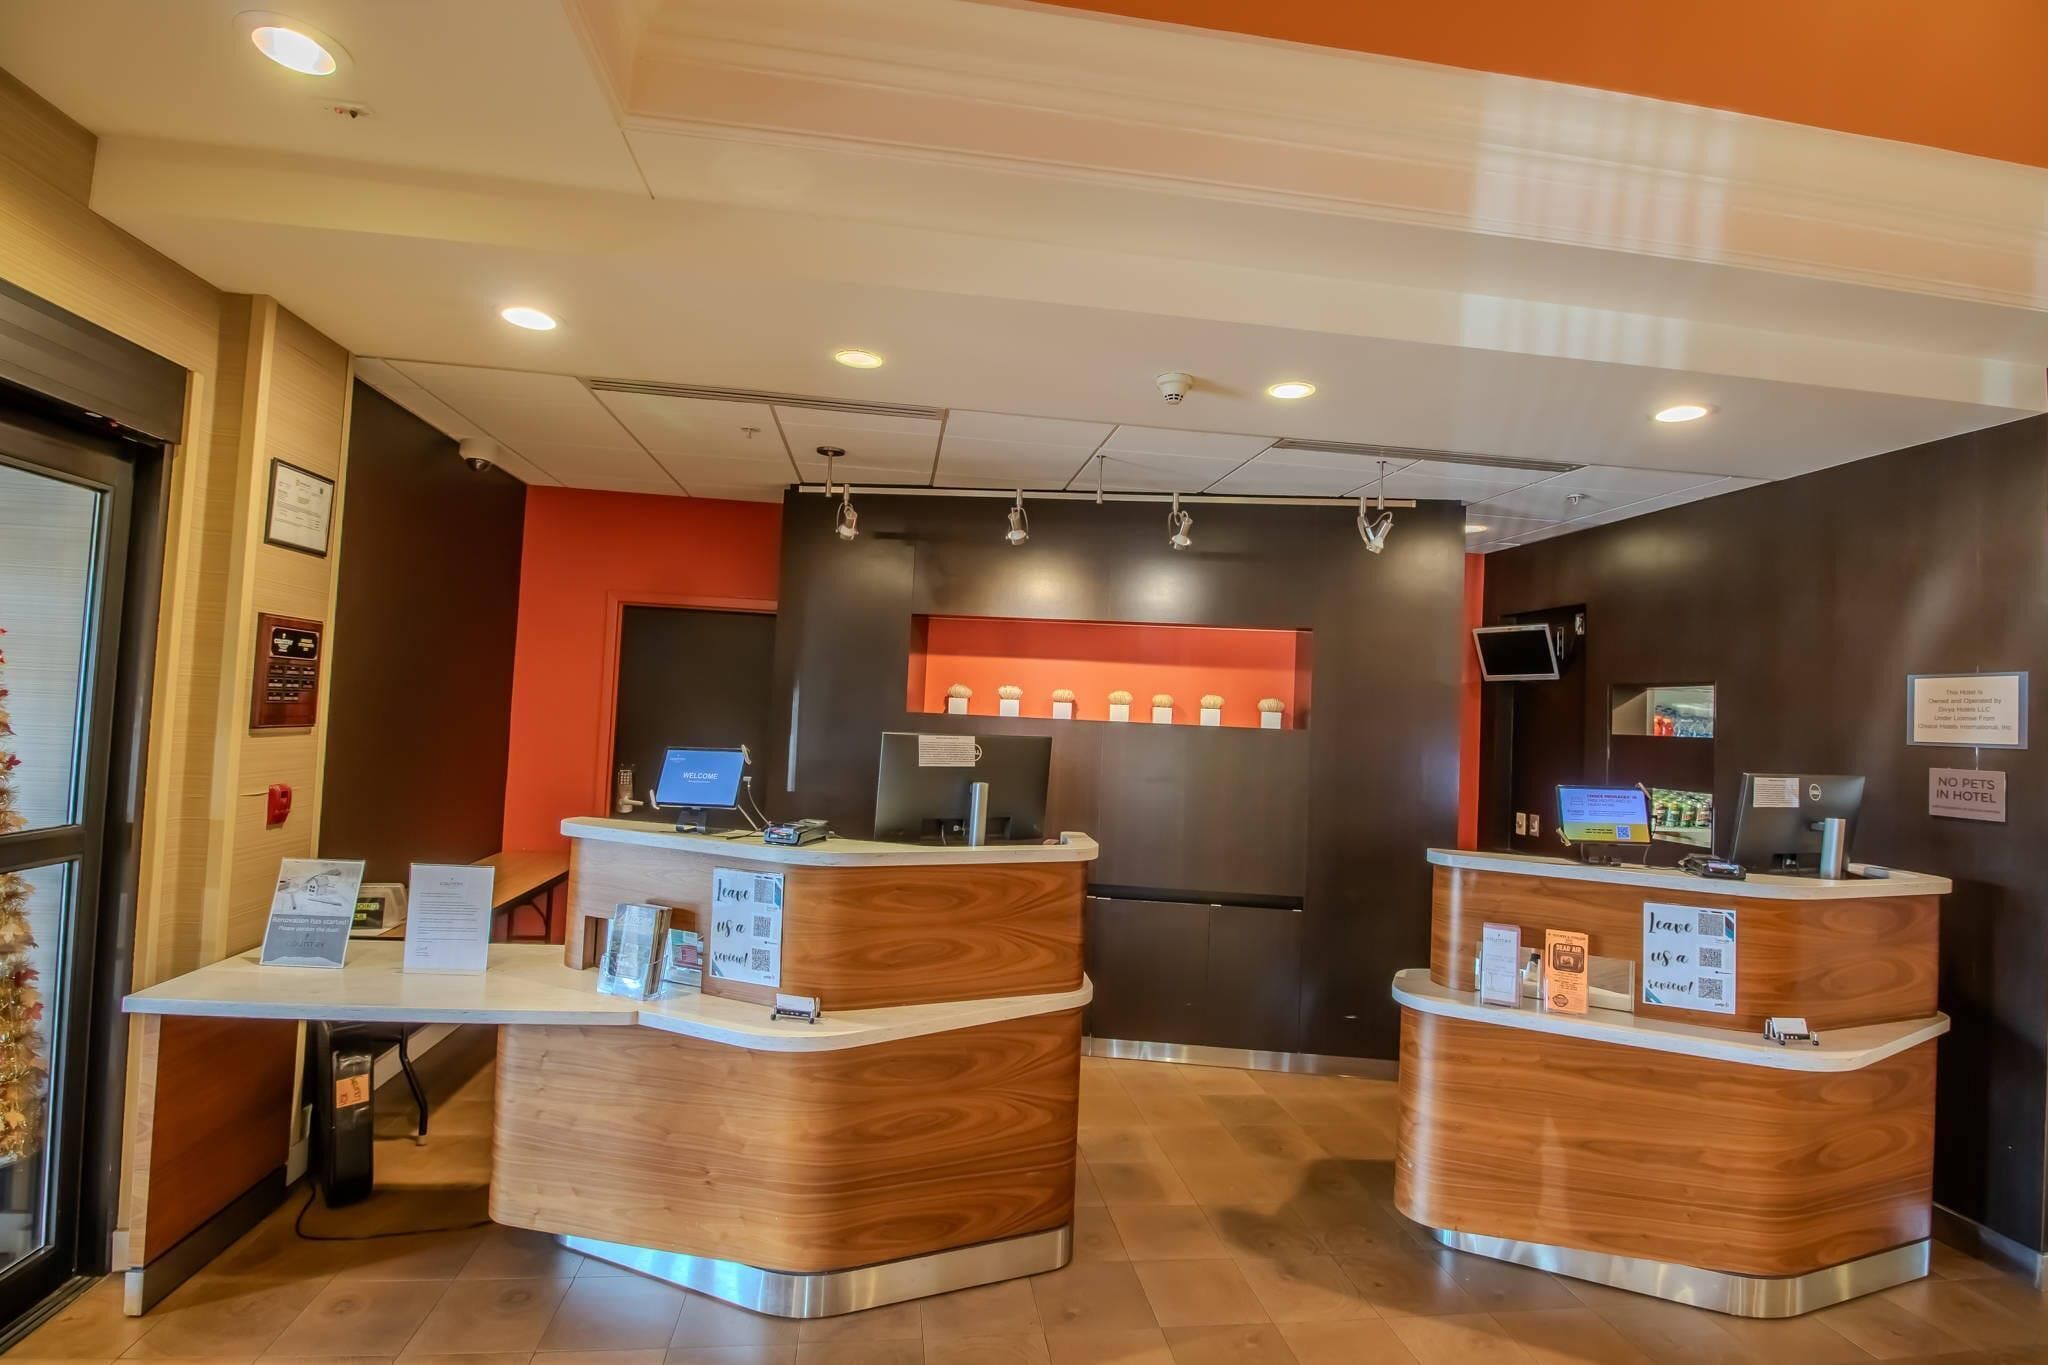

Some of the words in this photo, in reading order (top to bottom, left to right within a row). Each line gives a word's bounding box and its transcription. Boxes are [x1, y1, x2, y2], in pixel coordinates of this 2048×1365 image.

[683, 772, 719, 780] WELCOME
[1938, 776, 1958, 788] NO
[1962, 778, 1996, 791] PETS
[1936, 790, 1949, 800] IN
[1952, 790, 1997, 804] HOTEL
[717, 878, 750, 902] Leave
[716, 919, 733, 937] us
[735, 922, 746, 934] a
[1648, 911, 1694, 934] Leave
[714, 951, 749, 967] review!
[1651, 950, 1672, 966] us
[1676, 953, 1688, 964] a
[1647, 978, 1694, 995] review!
